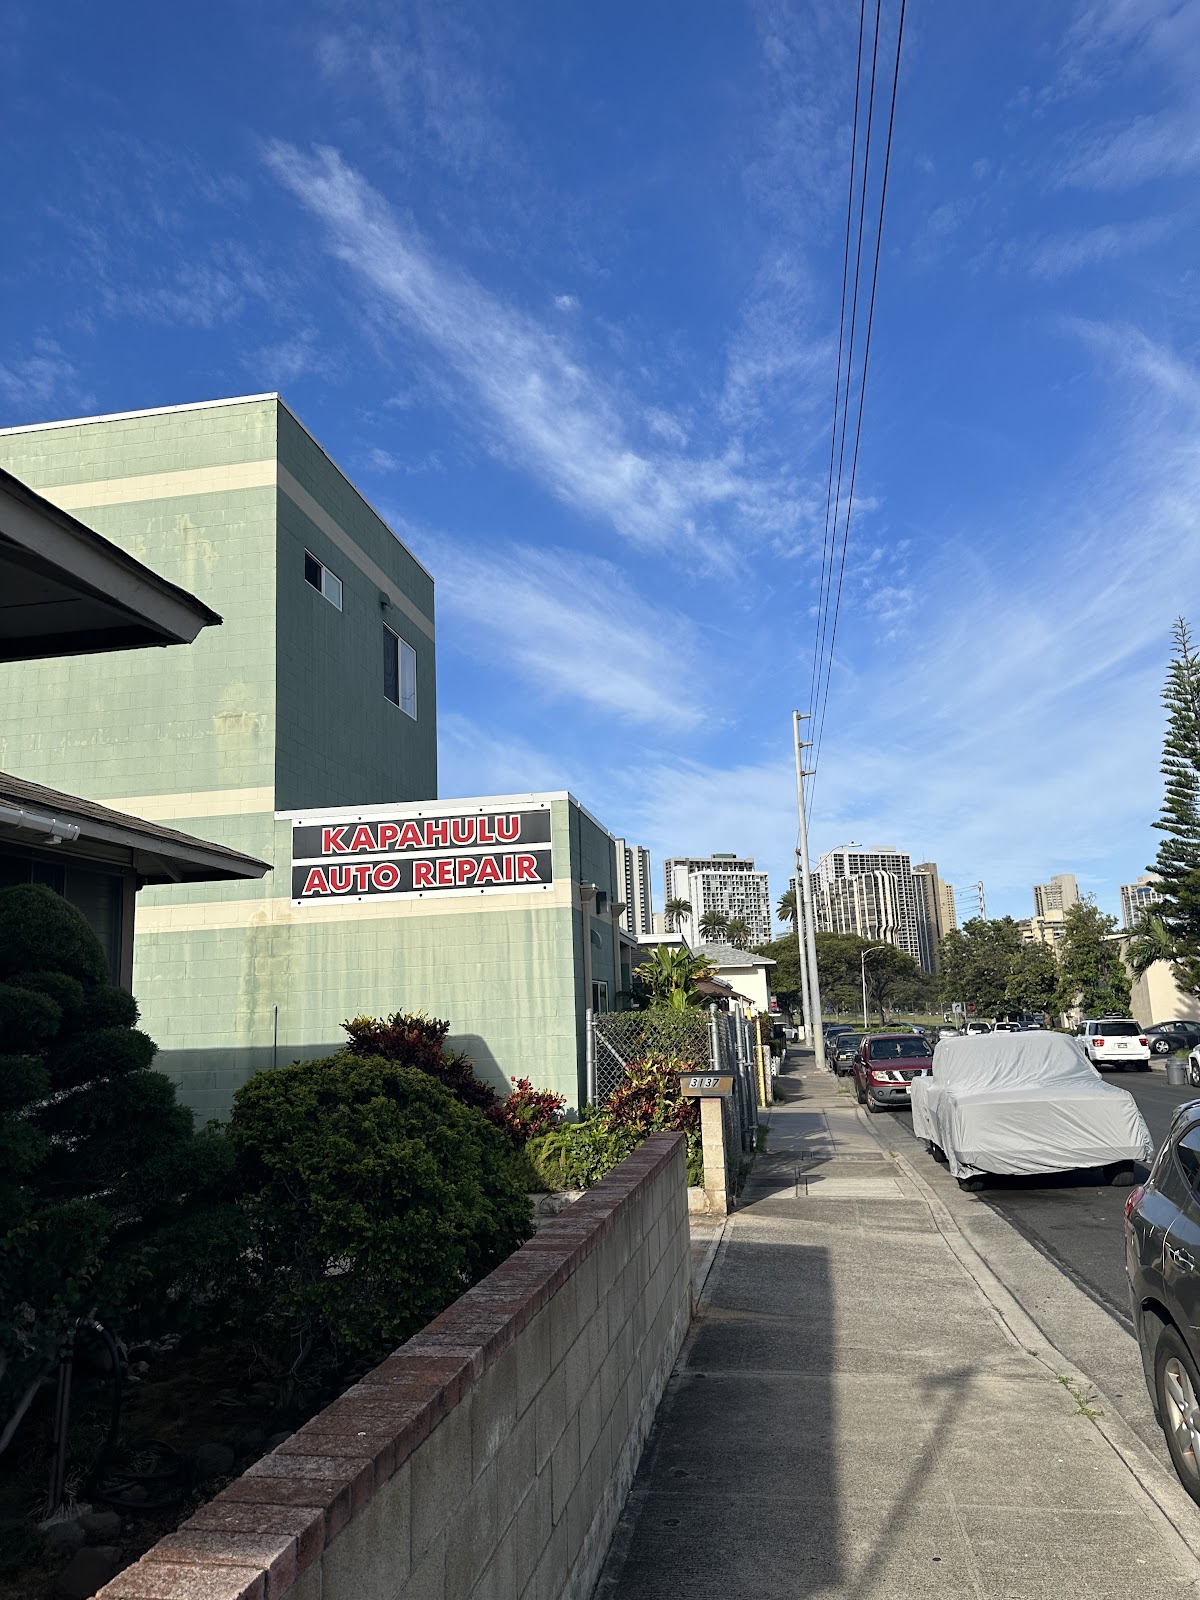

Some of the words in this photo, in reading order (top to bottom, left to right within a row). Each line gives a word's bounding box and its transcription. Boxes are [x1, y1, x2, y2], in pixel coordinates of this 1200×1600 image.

[322, 814, 521, 854] KAPAHULU
[302, 862, 401, 896] AUTO
[412, 854, 542, 888] REPAIR
[690, 1078, 720, 1088] 3137
